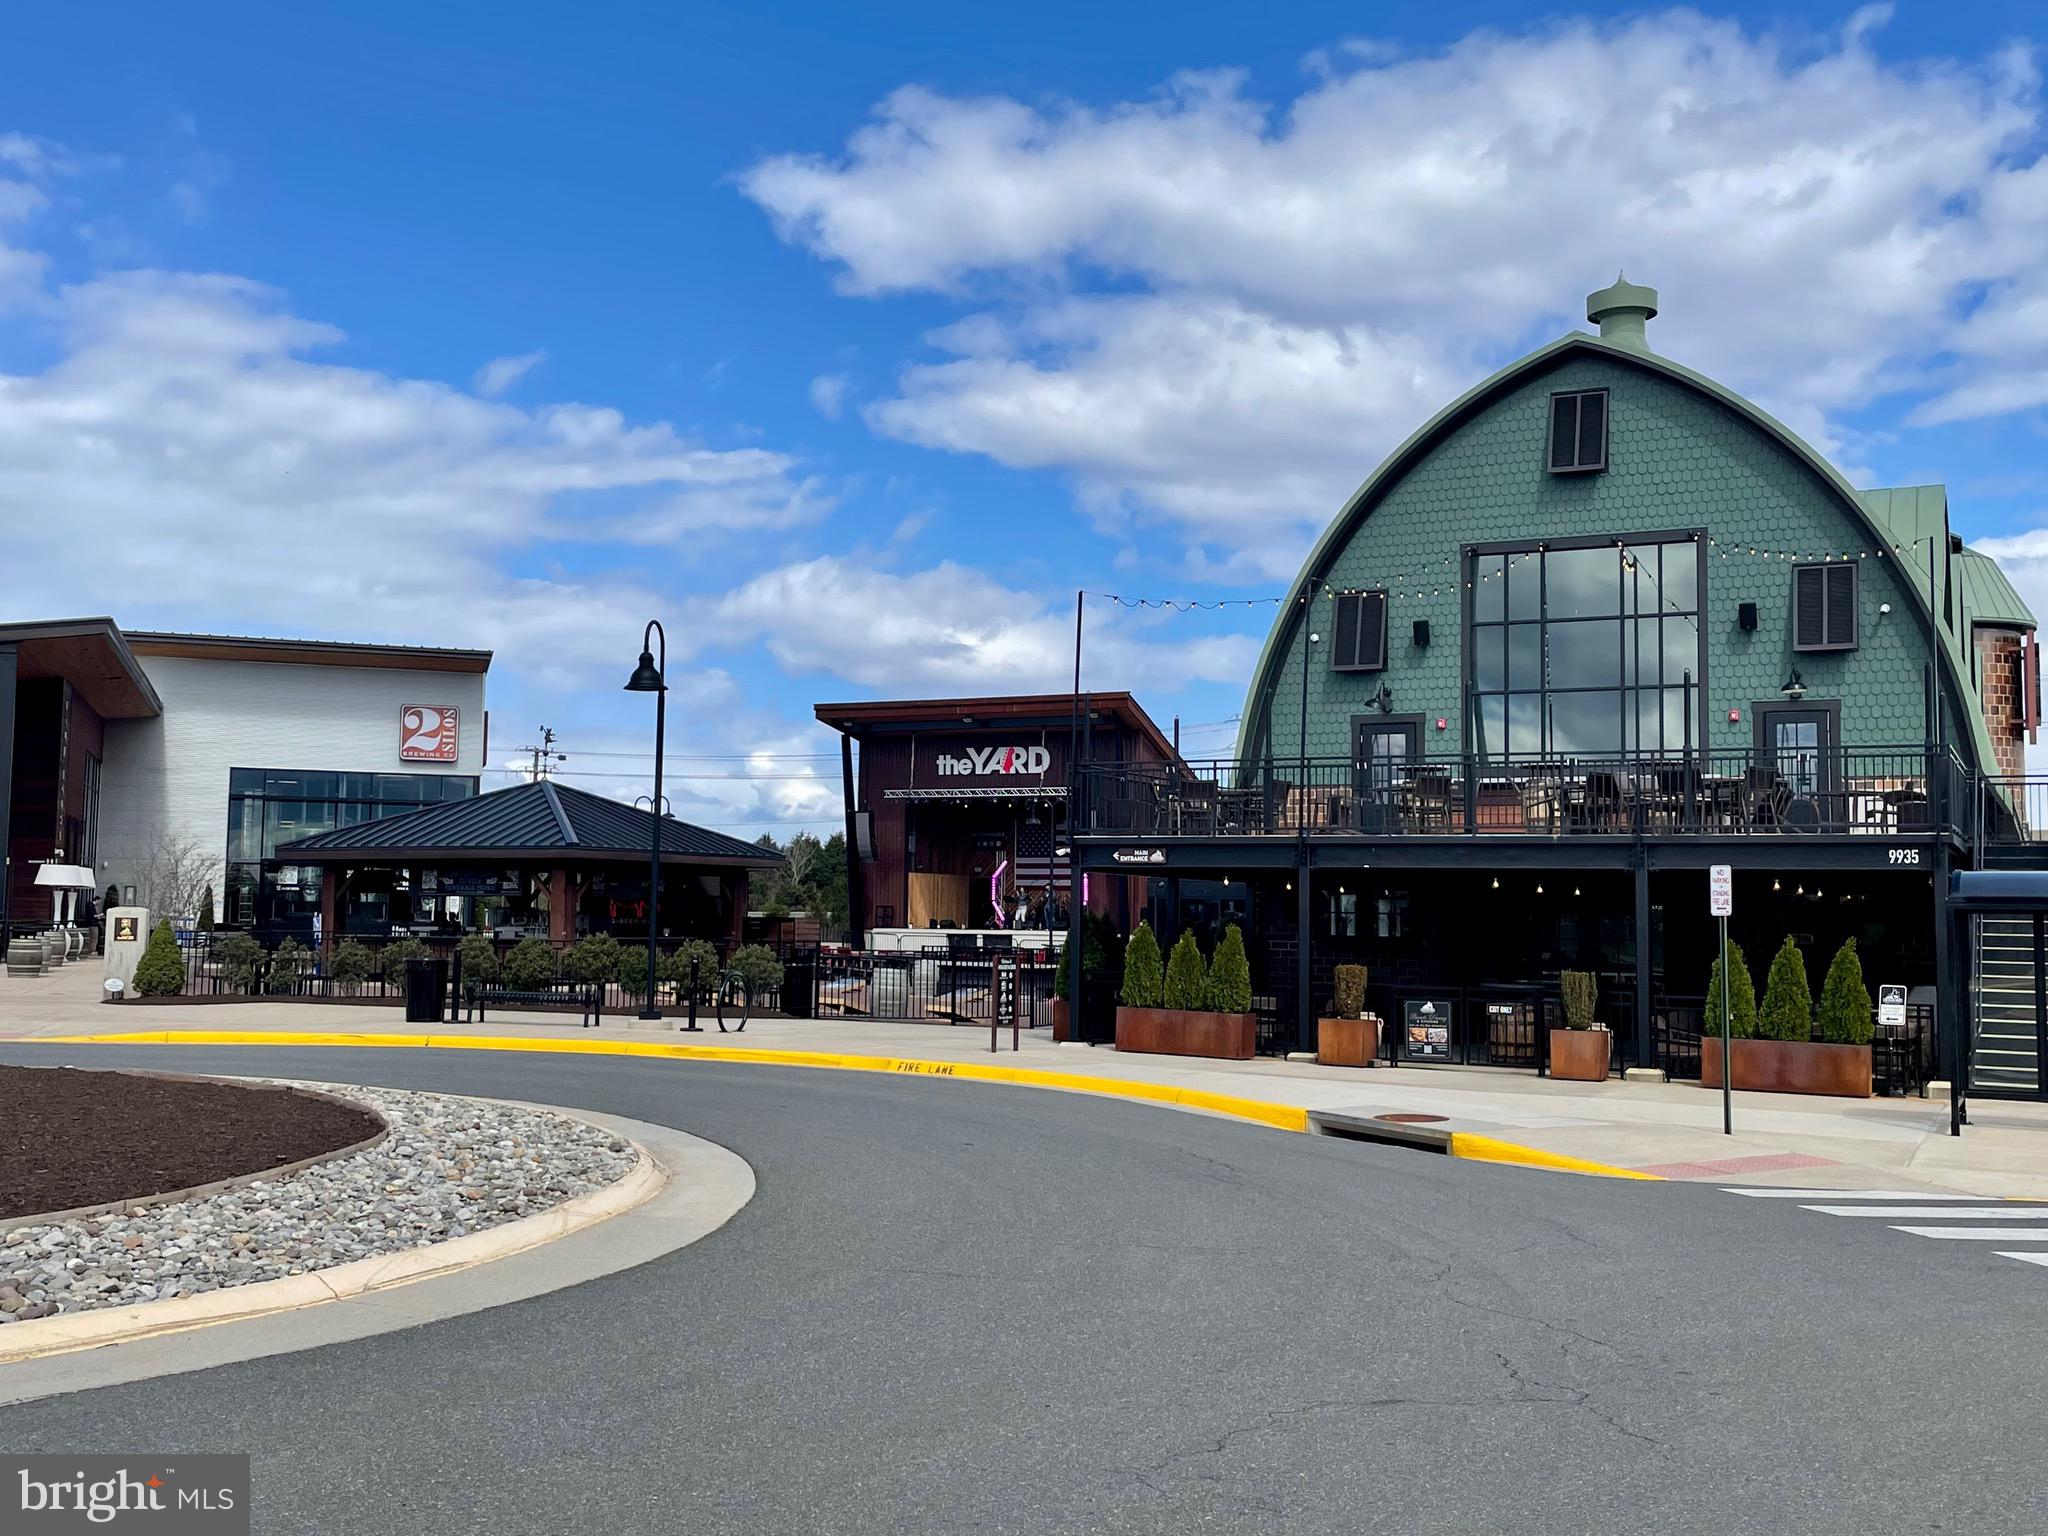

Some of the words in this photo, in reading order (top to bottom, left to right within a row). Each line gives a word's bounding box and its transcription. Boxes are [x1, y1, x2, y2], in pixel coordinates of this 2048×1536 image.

[403, 708, 441, 751] 2
[442, 710, 456, 752] SILOS
[1888, 849, 1919, 864] 9935
[897, 1061, 921, 1072] FIRE
[928, 1064, 956, 1075] LANE
